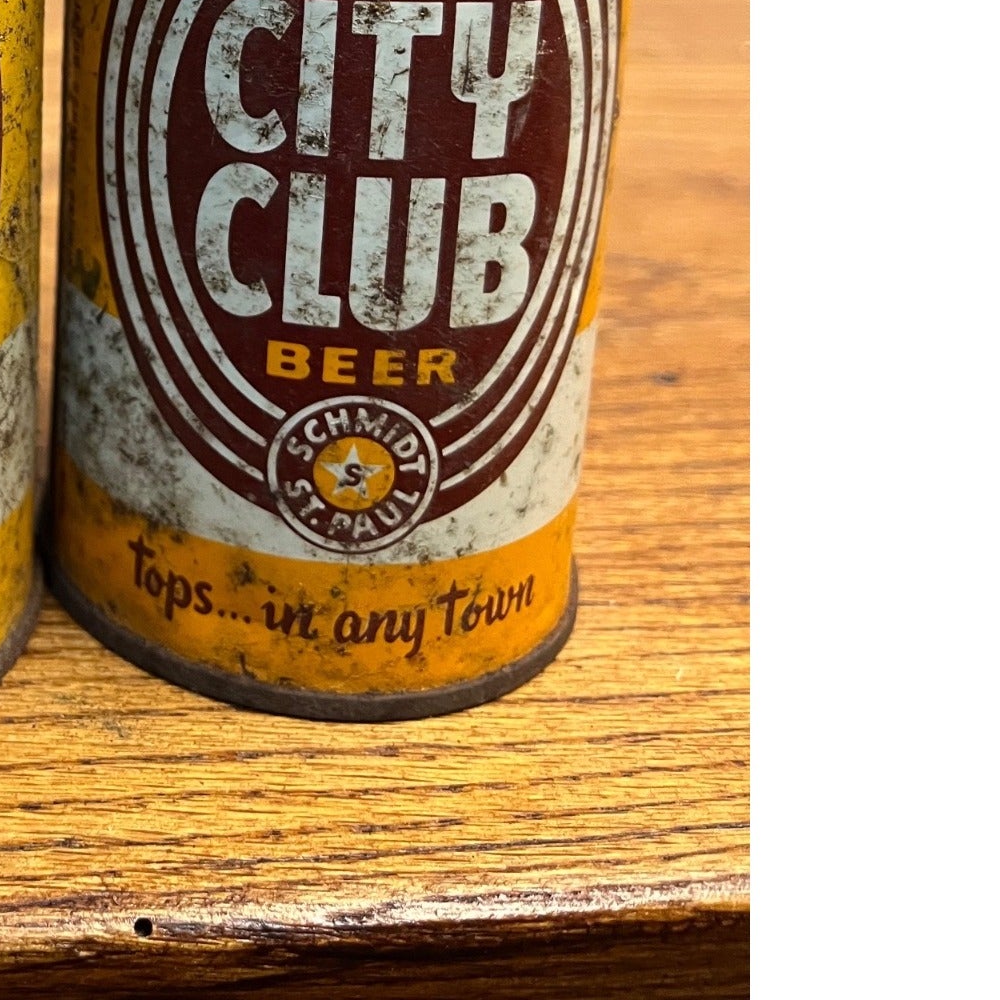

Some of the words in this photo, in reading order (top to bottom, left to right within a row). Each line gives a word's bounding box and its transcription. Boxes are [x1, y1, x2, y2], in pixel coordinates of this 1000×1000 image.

[195, 162, 537, 332] CLUB
[266, 339, 457, 386] BEER
[286, 407, 426, 475] SCHMIDT
[344, 463, 363, 487] S
[285, 478, 326, 526] ST.
[327, 489, 421, 539] PAUL
[261, 584, 319, 640] in
[333, 606, 426, 659] any
